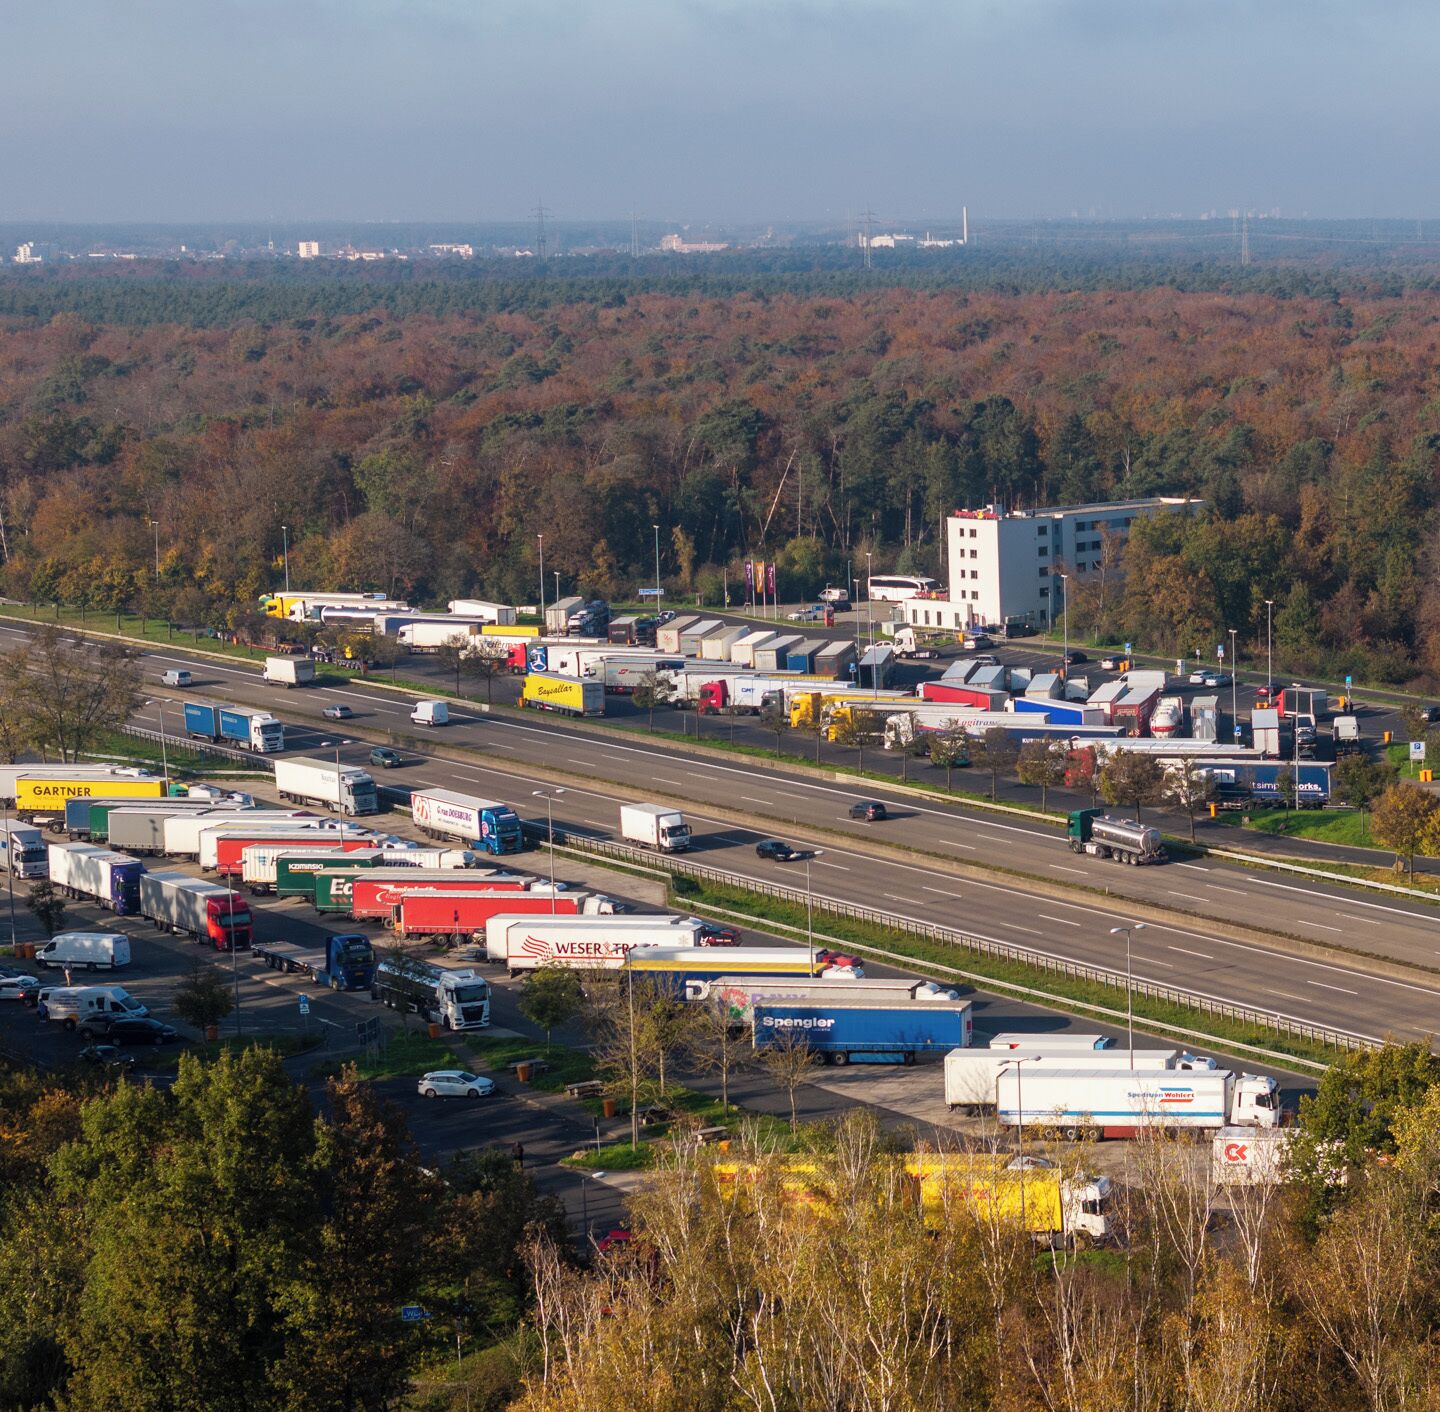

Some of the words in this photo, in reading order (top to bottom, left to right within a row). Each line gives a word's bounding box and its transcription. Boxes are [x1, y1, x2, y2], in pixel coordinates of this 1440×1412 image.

[538, 684, 573, 697] Baysallar
[33, 786, 91, 796] GARTNER
[555, 942, 604, 955] WESER
[763, 1016, 835, 1029] Spengler
